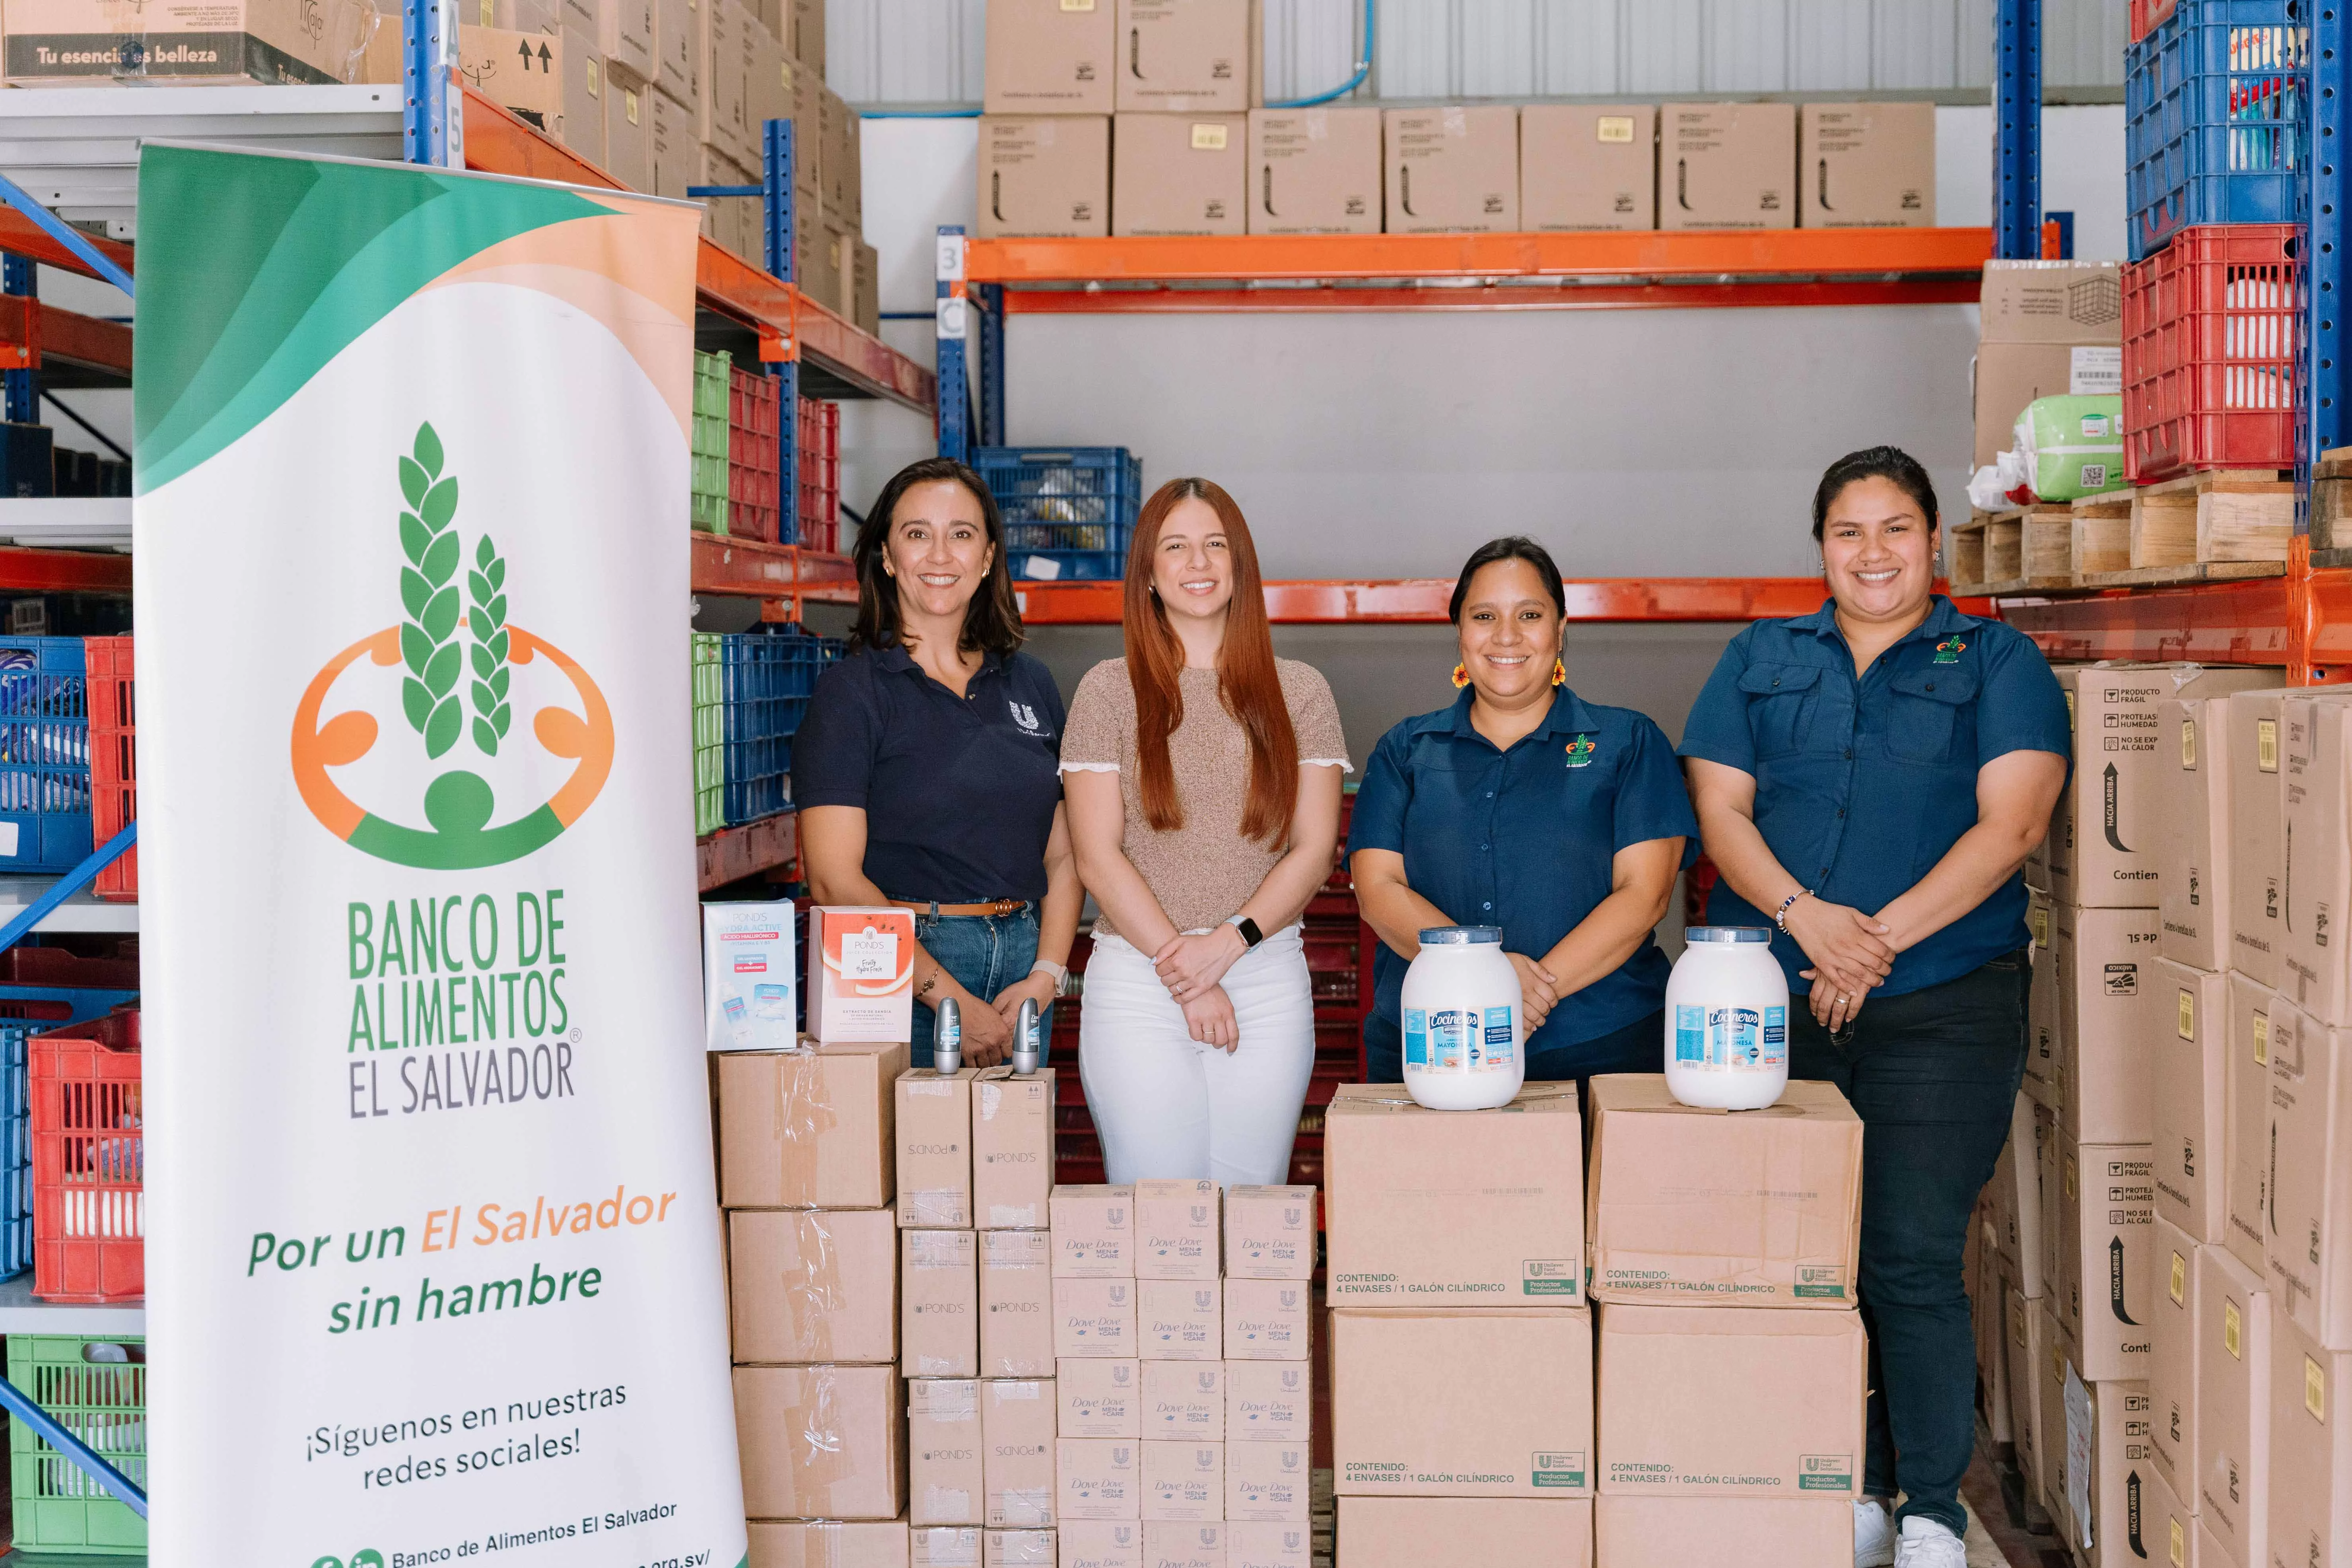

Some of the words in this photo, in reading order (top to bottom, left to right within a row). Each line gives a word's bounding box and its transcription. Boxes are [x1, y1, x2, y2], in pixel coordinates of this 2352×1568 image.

[37, 47, 57, 64] Tu
[155, 45, 218, 63] belleza
[451, 107, 461, 153] 5
[942, 248, 956, 270] 3
[940, 301, 962, 333] C
[733, 913, 767, 922] POND'S
[348, 893, 498, 979] BANCO
[516, 889, 566, 967] DE
[2127, 934, 2141, 943] 5L
[2143, 933, 2158, 943] de
[856, 965, 869, 974] Hydra
[347, 968, 568, 1053] ALIMENTOS
[1431, 1013, 1477, 1026] Cocineos
[1711, 1012, 1757, 1024] Cocneros
[349, 1059, 389, 1119] EL
[400, 1041, 574, 1114] SALVADOR
[908, 1144, 947, 1154] POND'S
[996, 1152, 1036, 1163] POND'S
[247, 1231, 330, 1277] Por
[345, 1225, 406, 1263] un
[421, 1205, 461, 1253] El
[472, 1185, 676, 1245] Salvador
[1066, 1239, 1093, 1249] Dove
[1096, 1239, 1119, 1248] Dove
[1149, 1237, 1176, 1247] Dove
[1179, 1237, 1202, 1246] Dove
[1242, 1239, 1269, 1249] Dove
[1273, 1239, 1295, 1248] Dove
[1336, 1273, 1399, 1282] CONTENIDO:
[1606, 1270, 1670, 1279] CONTENIDO:
[1408, 1282, 1444, 1292] GALÓN
[1447, 1282, 1505, 1292] CILÍNDRICO
[1679, 1281, 1714, 1291] GALÓN
[1718, 1282, 1775, 1293] CILÍNDRICO
[327, 1286, 400, 1334] sin
[416, 1263, 602, 1322] hambre
[925, 1303, 965, 1314] POND'S
[1000, 1302, 1040, 1313] POND'S
[1153, 1322, 1180, 1332] Dove
[1183, 1322, 1206, 1331] Dove
[306, 1412, 453, 1462] ¡Síguenos
[462, 1405, 497, 1430] en
[507, 1384, 627, 1423] nuestras
[933, 1450, 973, 1460] POND'S
[995, 1446, 1035, 1456] POND'S
[363, 1454, 447, 1490] redes
[456, 1428, 581, 1470] sociales!
[1346, 1463, 1409, 1471] CONTENIDO:
[1611, 1463, 1674, 1473] CONTENIDO:
[1354, 1473, 1401, 1482] ENVASES
[1403, 1474, 1407, 1482] /
[1418, 1472, 1453, 1483] GALÓN
[1456, 1472, 1514, 1483] CILÍNDRICO
[1683, 1473, 1719, 1484] GALÓN
[1722, 1475, 1781, 1485] CILÍNDRICO
[393, 1547, 451, 1568] Banco
[457, 1540, 479, 1557] de
[486, 1524, 576, 1552] Alimentos
[582, 1516, 598, 1534] El
[605, 1503, 677, 1530] Salvador
